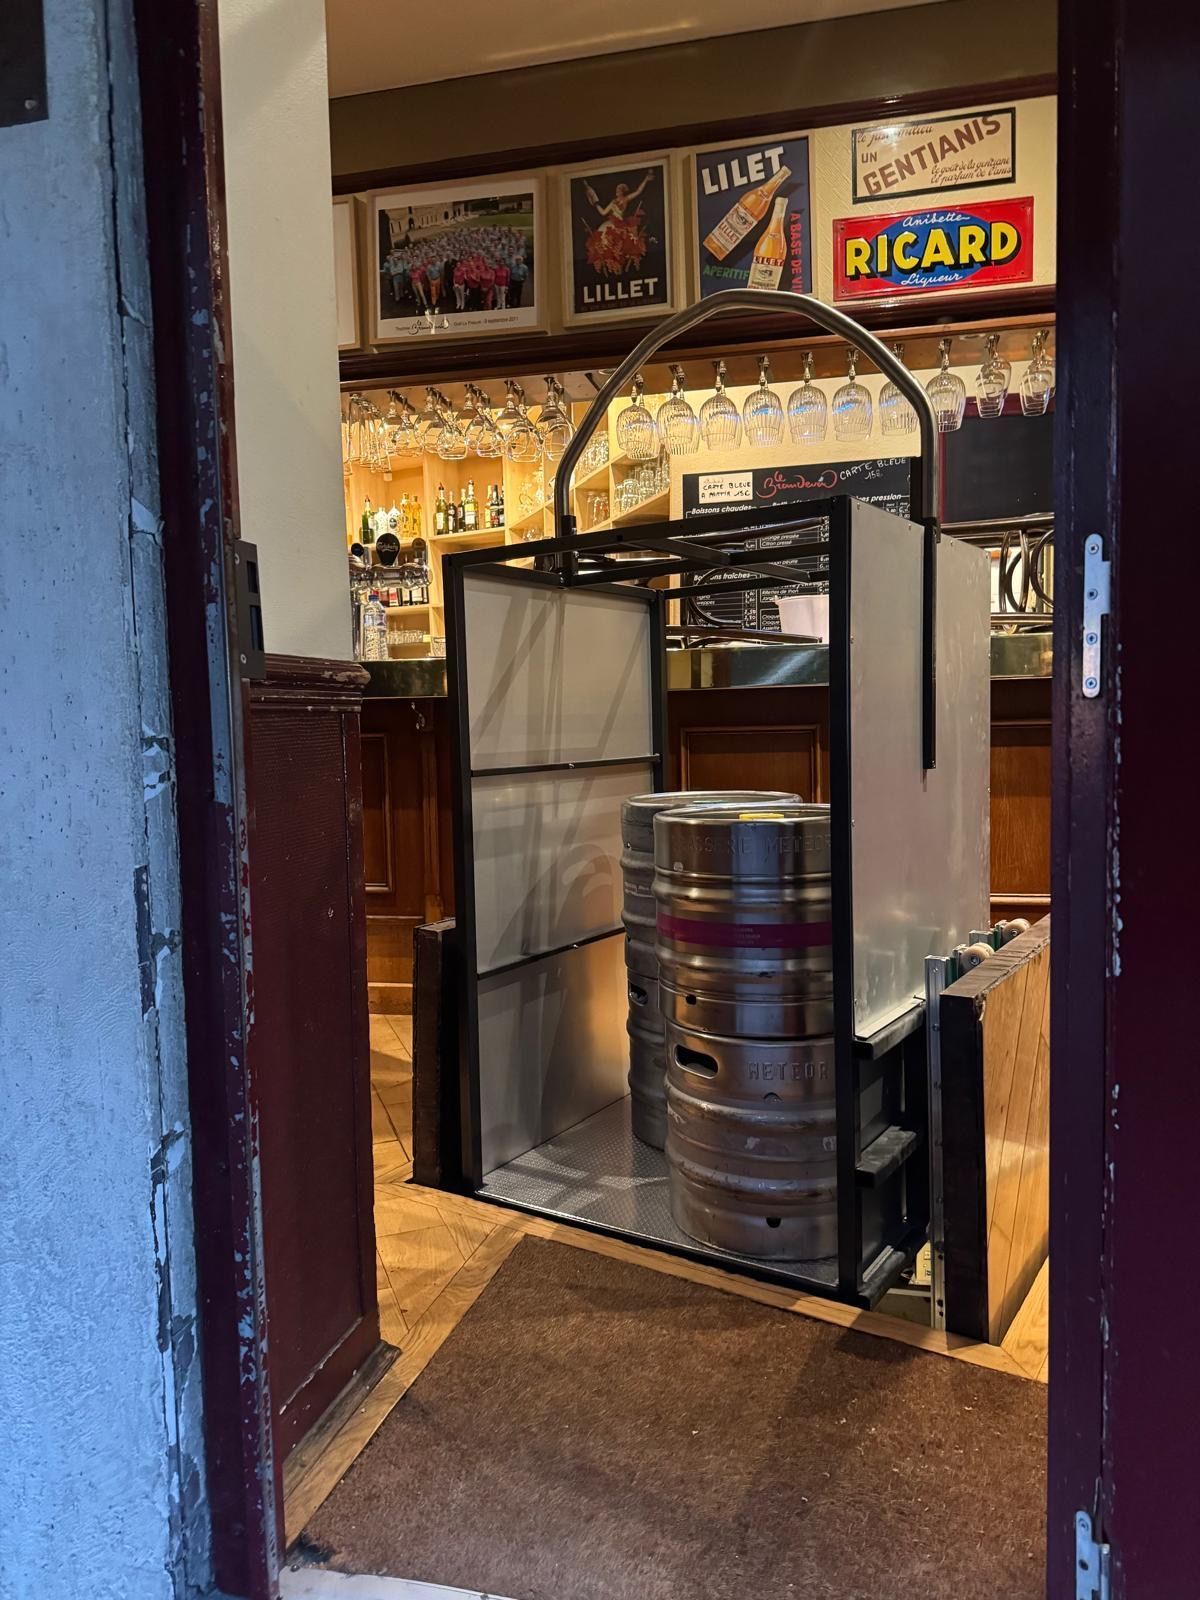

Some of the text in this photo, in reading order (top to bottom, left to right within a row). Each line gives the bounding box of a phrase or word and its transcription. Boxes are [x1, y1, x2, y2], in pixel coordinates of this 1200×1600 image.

[861, 152, 878, 163] UN
[862, 116, 1001, 196] GENTIANIS
[701, 146, 784, 195] LILET
[902, 212, 971, 228] Anisette
[790, 223, 802, 256] BASE
[845, 221, 1020, 279] RICARD
[791, 259, 803, 275] DE
[901, 272, 964, 288] Liqueur
[583, 277, 658, 303] LILLET
[839, 457, 907, 481] CARTE BLEUE
[702, 481, 751, 491] CARTE BLEUE
[870, 492, 902, 504] pression
[691, 504, 752, 515] Boissons chaudes
[723, 572, 751, 580] fraîches
[747, 1061, 829, 1081] METEOR
